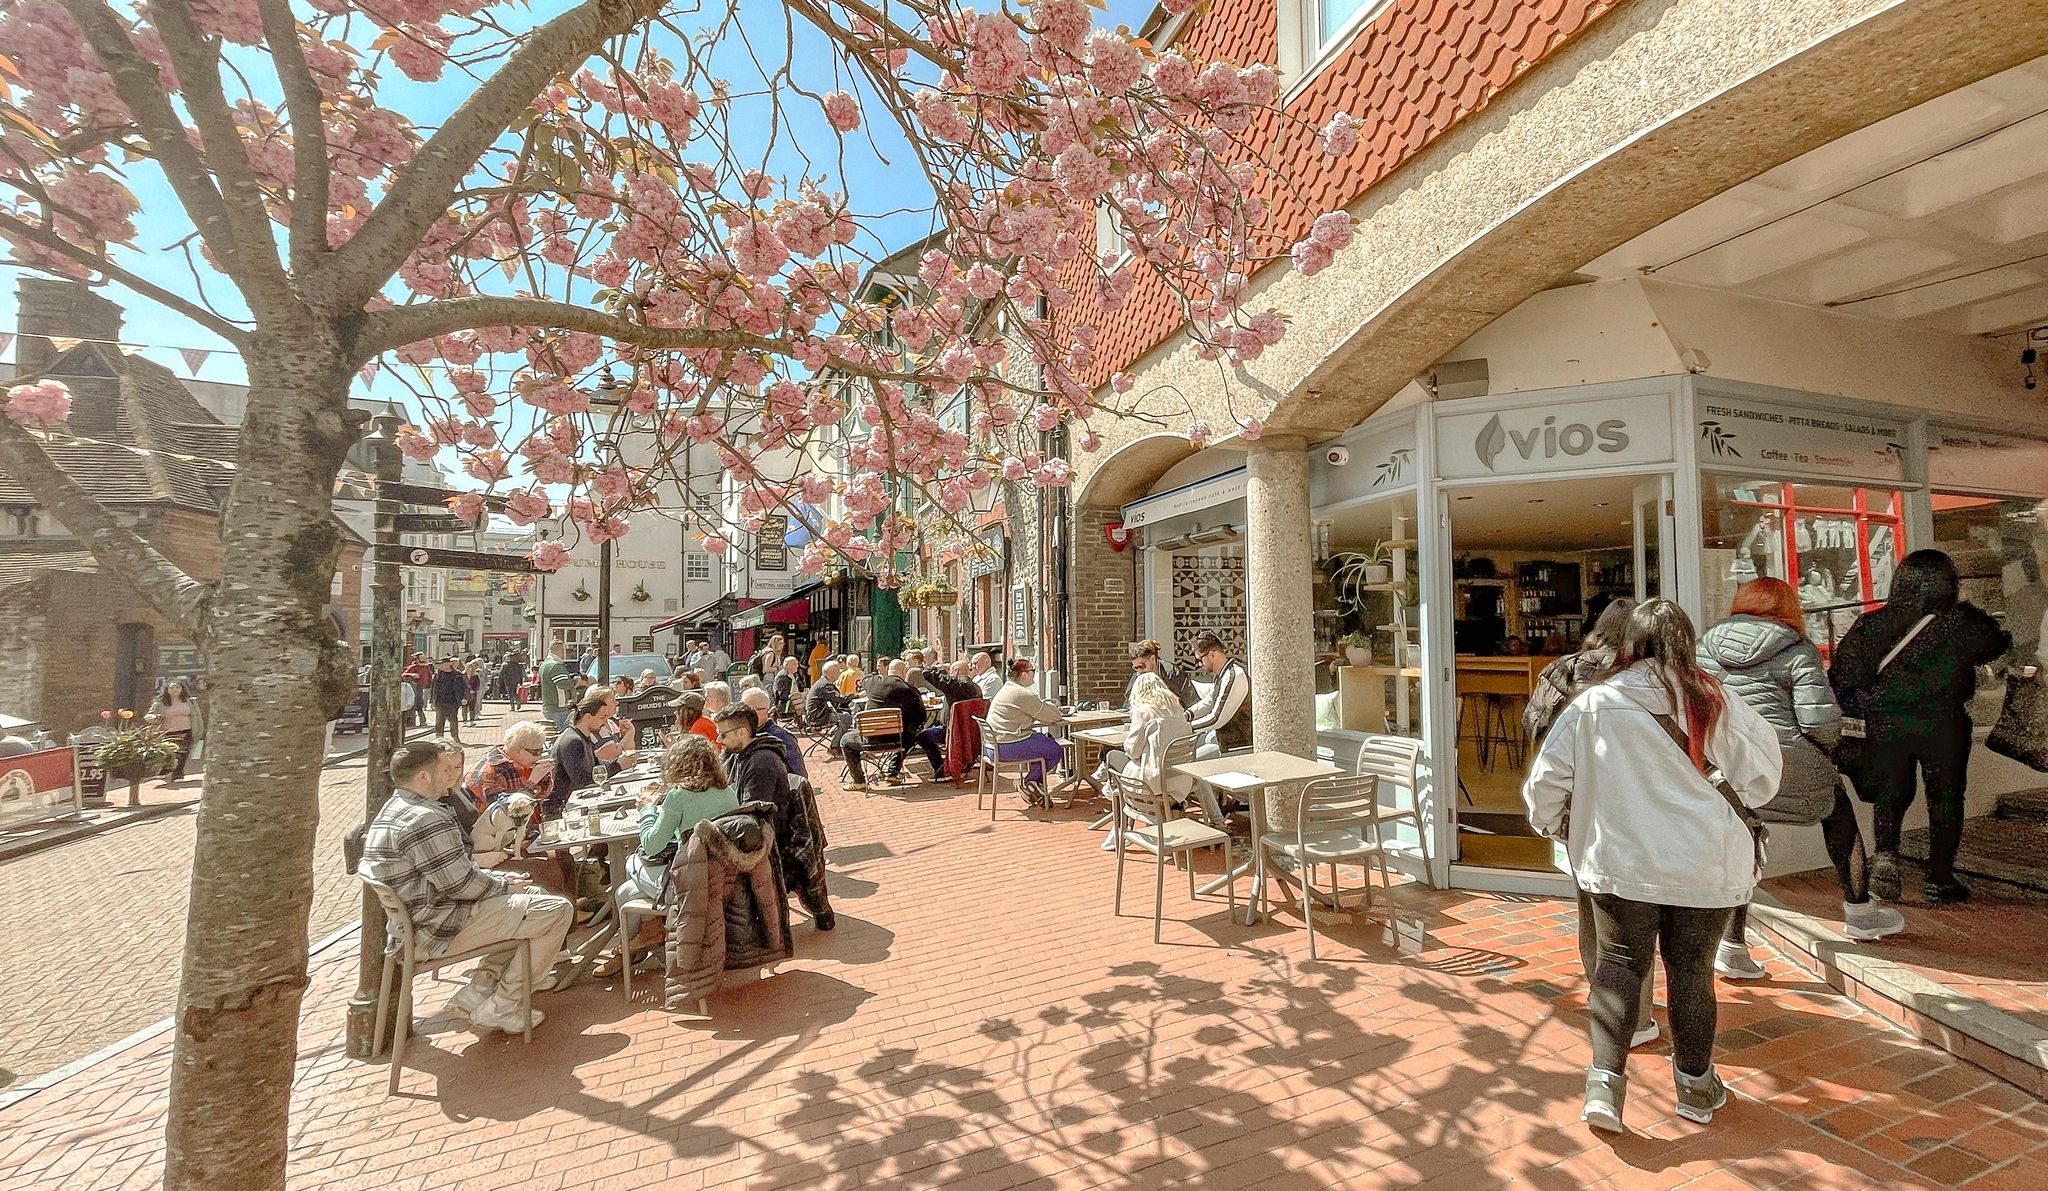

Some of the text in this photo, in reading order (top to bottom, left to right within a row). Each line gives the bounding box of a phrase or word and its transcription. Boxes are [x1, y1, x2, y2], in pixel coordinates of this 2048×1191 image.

[1706, 405, 1732, 417] FRESH
[1733, 408, 1784, 424] SANDWICHES
[1788, 416, 1811, 427] PITTA
[1811, 419, 1840, 431] BREADS
[1844, 423, 1871, 435] SALADS
[1508, 415, 1630, 460] vios
[1760, 448, 1788, 461] Coffee
[1794, 452, 1809, 463] Tea
[1130, 511, 1145, 524] vios
[616, 559, 667, 569] HOUSE
